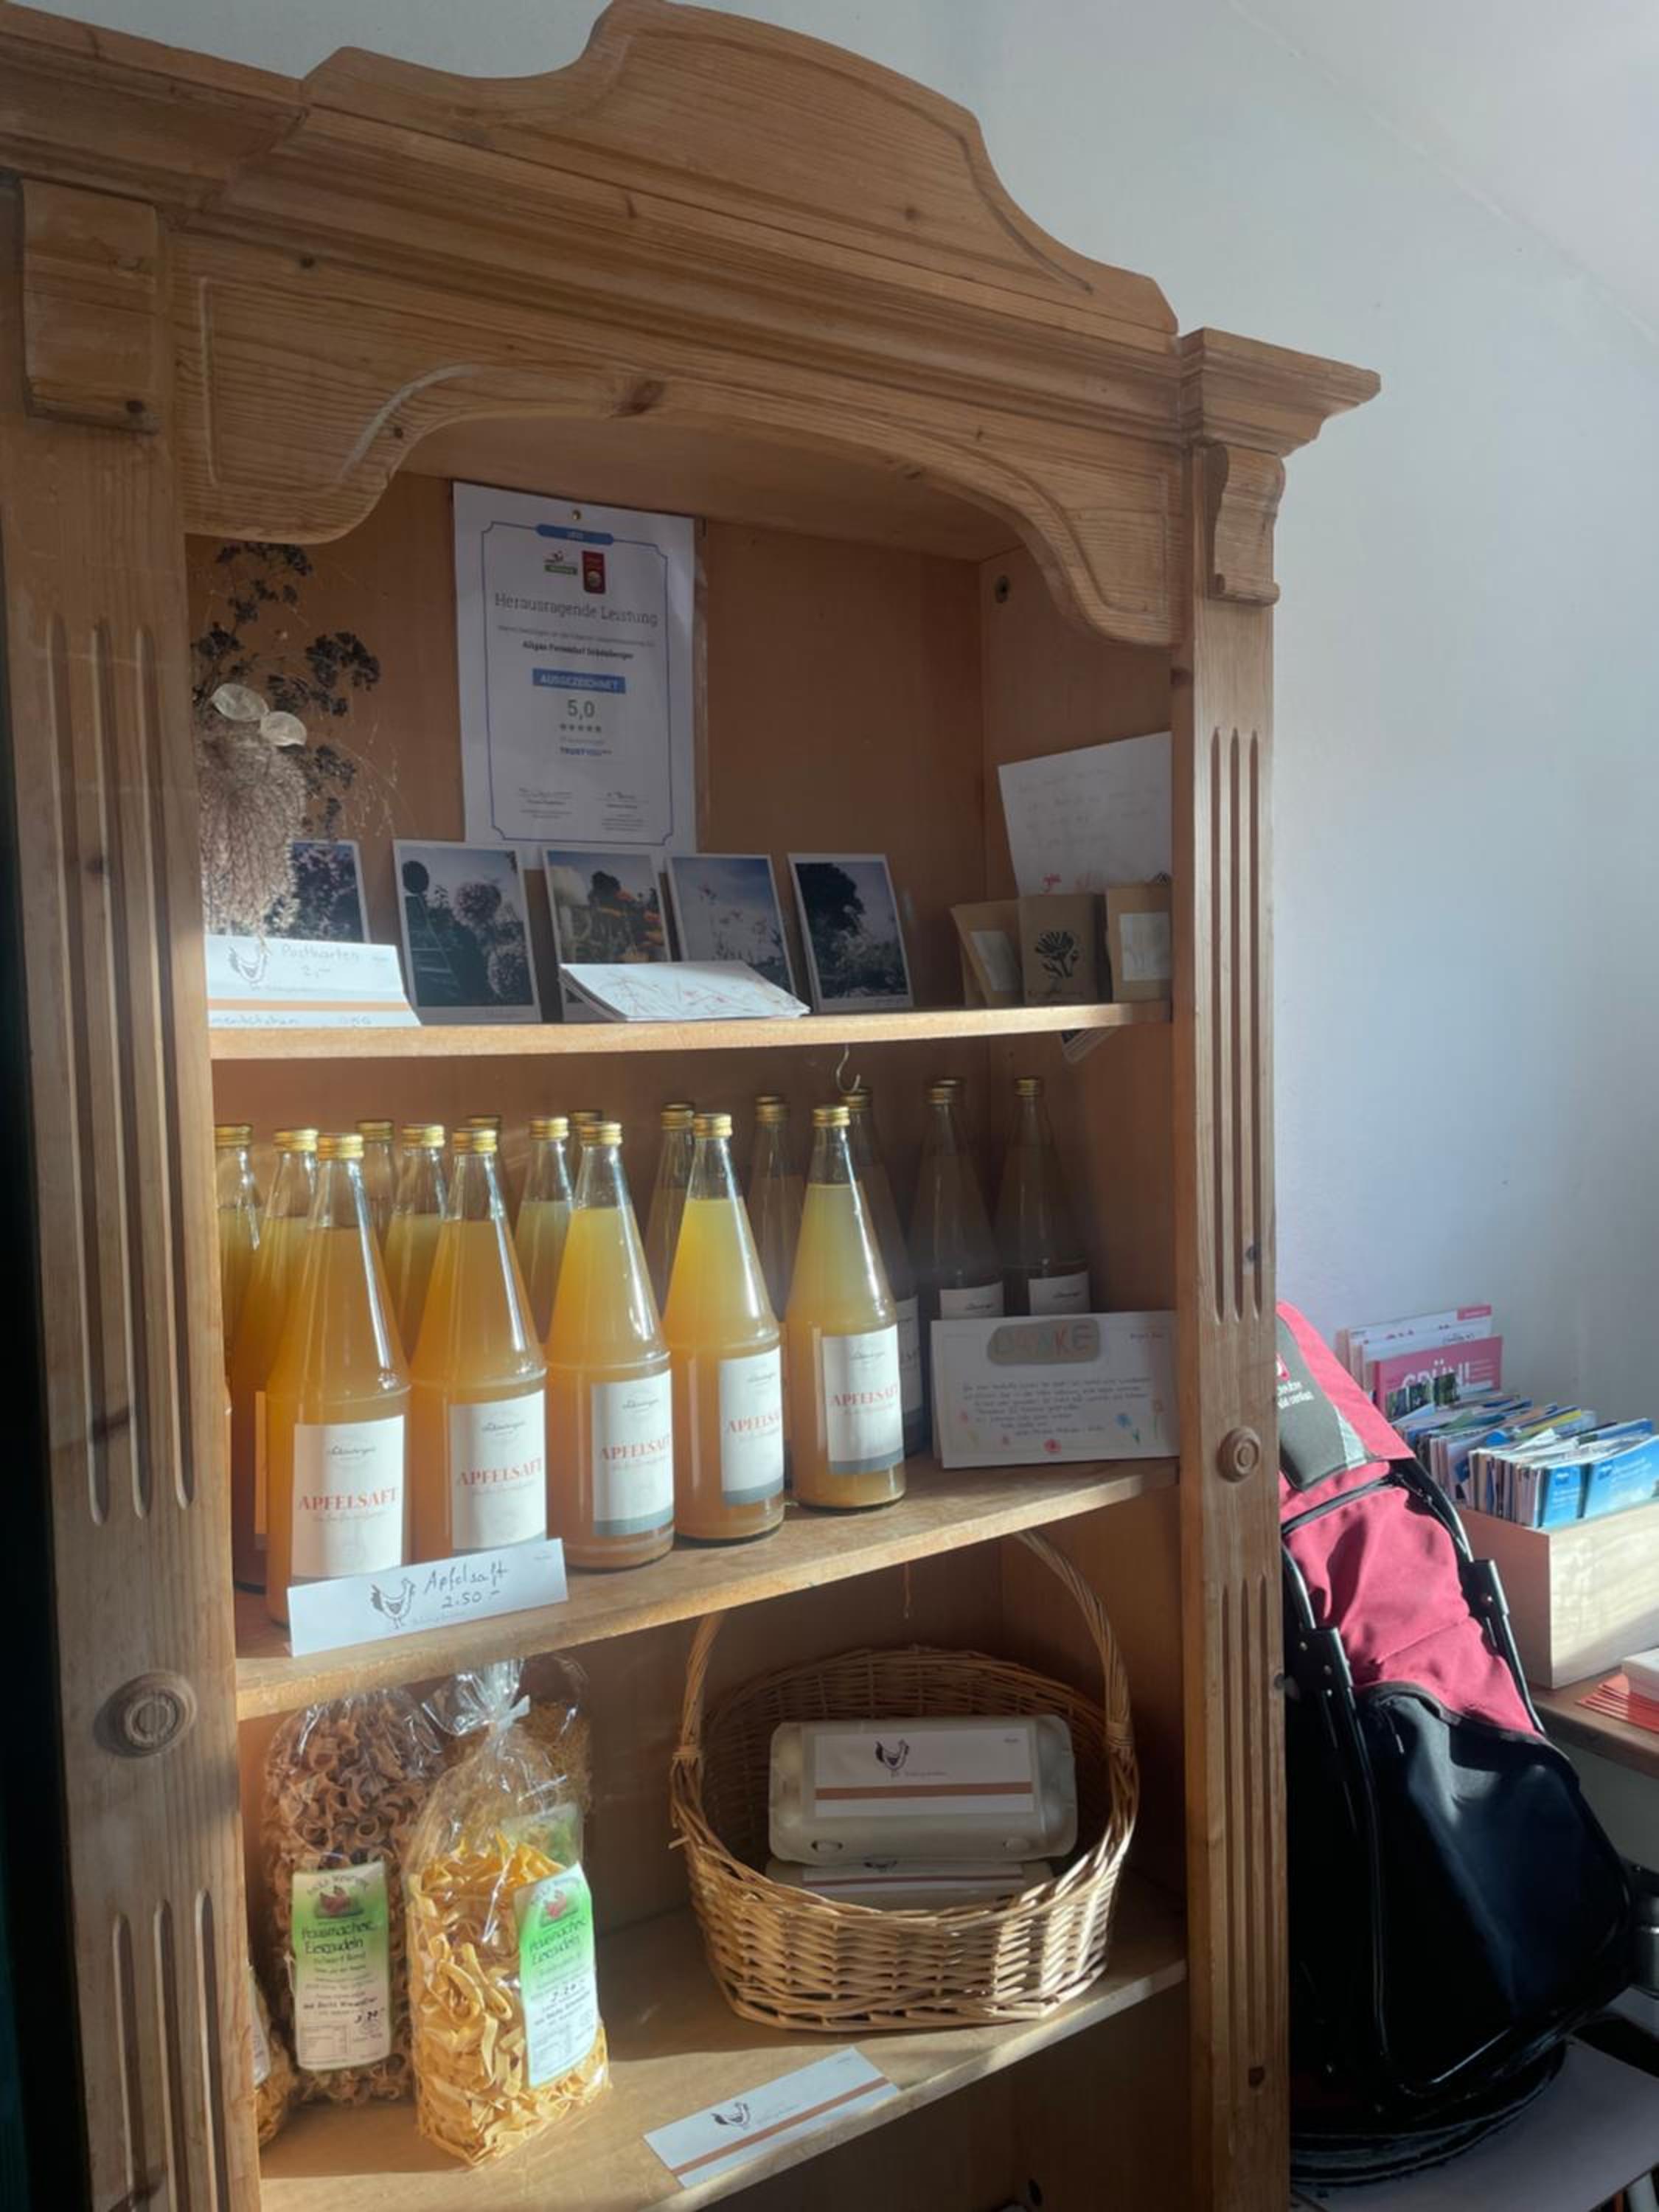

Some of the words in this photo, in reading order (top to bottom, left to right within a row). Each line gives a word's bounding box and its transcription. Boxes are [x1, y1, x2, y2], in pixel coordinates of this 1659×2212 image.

[495, 590, 597, 618] Herausragende
[601, 605, 658, 627] Leistung
[540, 672, 619, 690] AUSGEZEICHNET
[567, 699, 595, 720] 5,0
[458, 1457, 542, 1486] APFELSAFT
[298, 1487, 397, 1511] APFELSAFT
[424, 1559, 509, 1594] Apfelsaft
